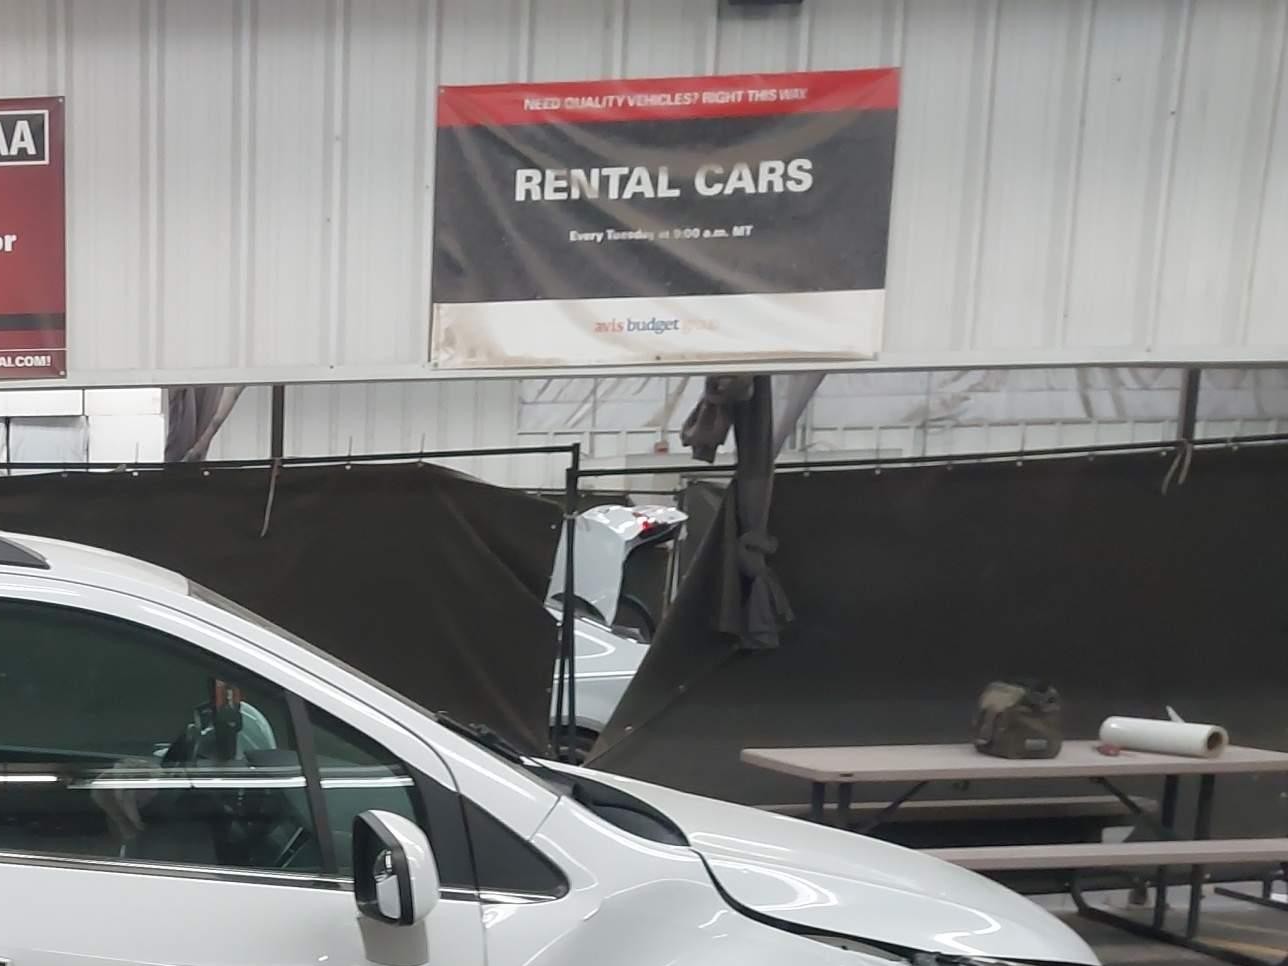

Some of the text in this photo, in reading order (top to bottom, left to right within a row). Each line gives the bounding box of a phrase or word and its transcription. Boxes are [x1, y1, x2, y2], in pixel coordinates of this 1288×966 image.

[524, 98, 560, 110] NEED
[564, 95, 626, 109] QUALITY
[627, 93, 700, 107] VEHICLES?
[702, 90, 745, 104] RIGHT
[747, 89, 777, 102] THIS
[514, 158, 814, 201] RENTAL CARS
[569, 230, 604, 243] Every
[606, 229, 655, 241] Tuesday
[731, 226, 754, 237] MT
[594, 317, 624, 333] avis
[626, 317, 680, 334] budget
